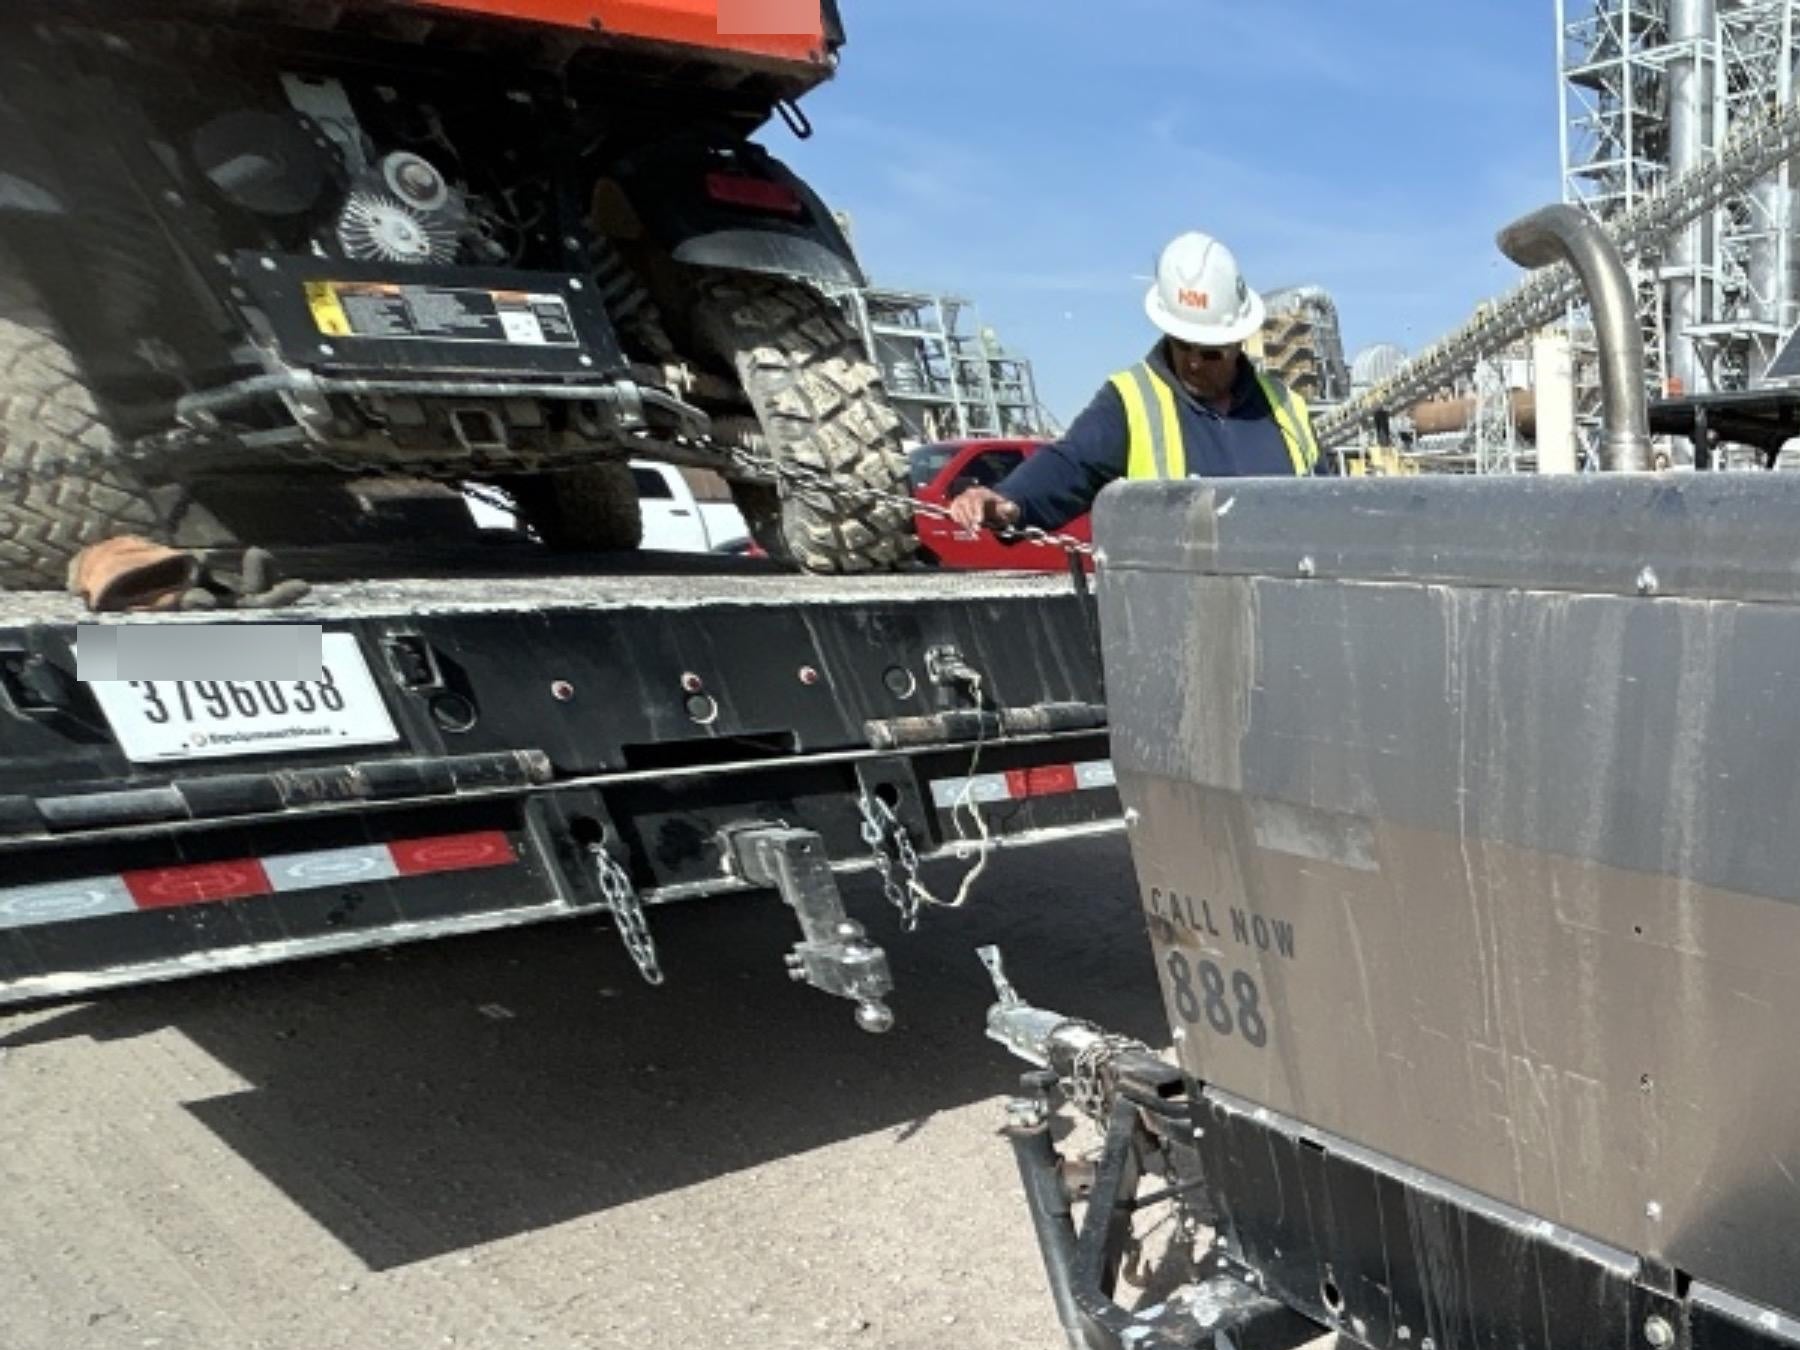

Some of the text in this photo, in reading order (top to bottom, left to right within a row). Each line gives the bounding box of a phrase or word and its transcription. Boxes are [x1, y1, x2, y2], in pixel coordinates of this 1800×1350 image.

[1151, 887, 1295, 960] CALL NOW
[1166, 950, 1267, 1048] 888
